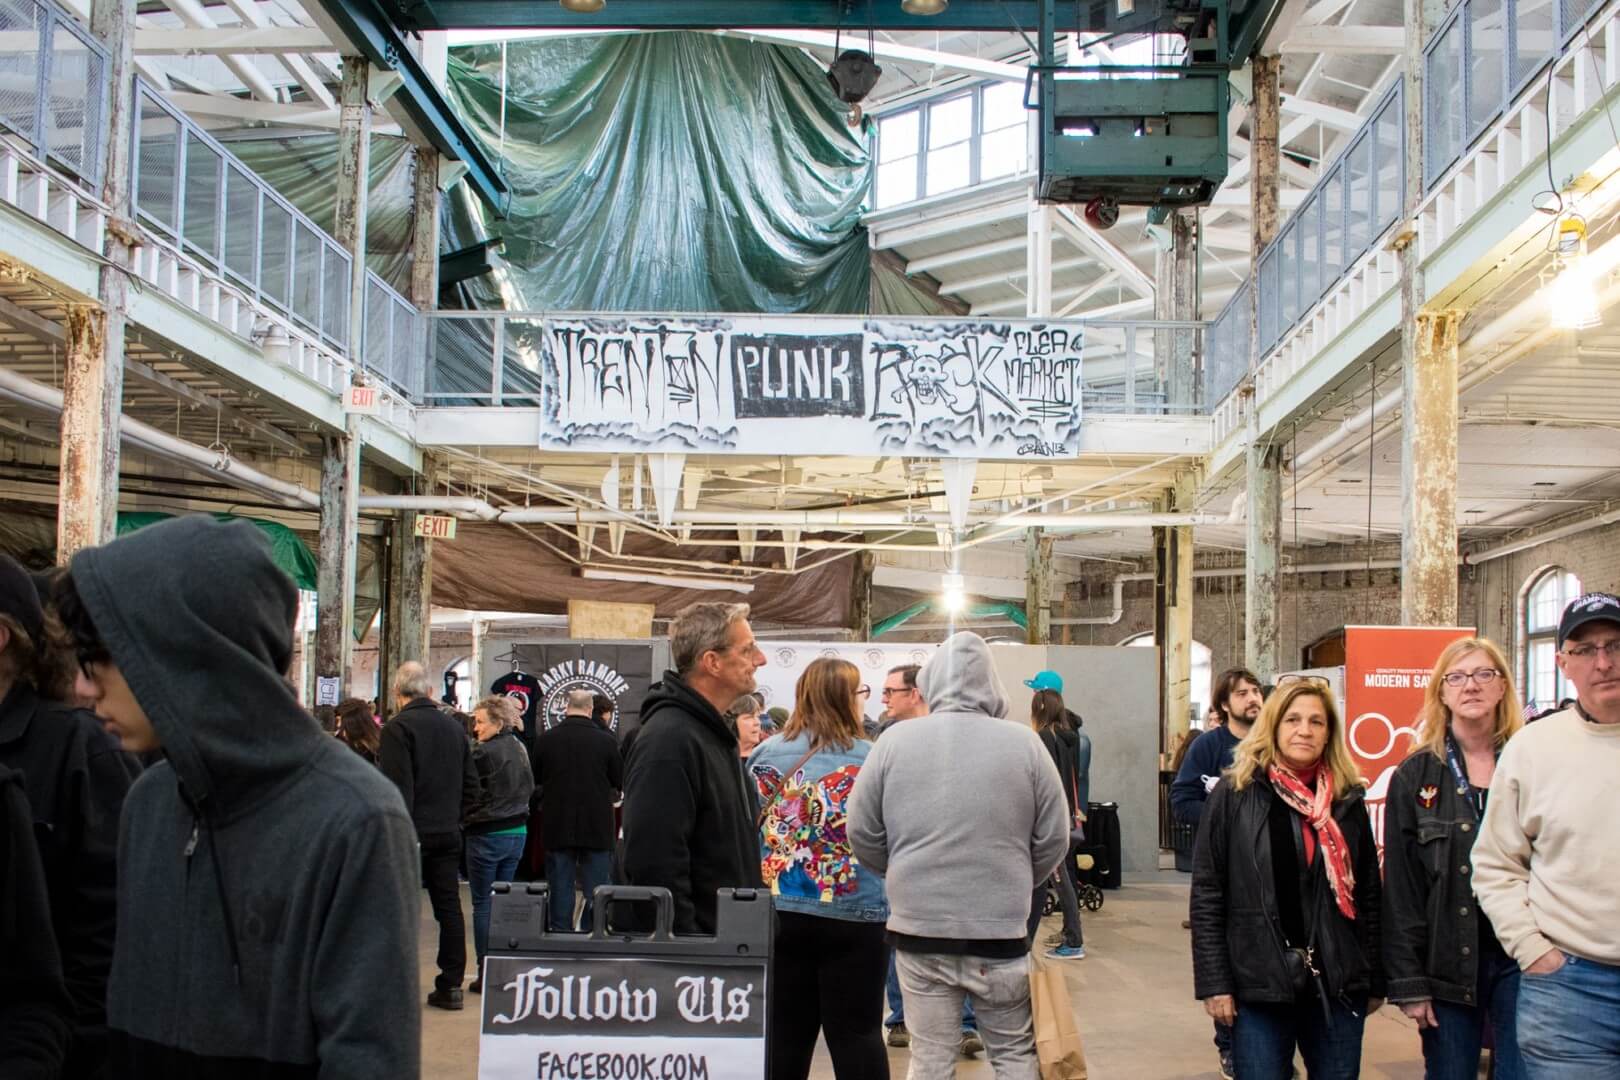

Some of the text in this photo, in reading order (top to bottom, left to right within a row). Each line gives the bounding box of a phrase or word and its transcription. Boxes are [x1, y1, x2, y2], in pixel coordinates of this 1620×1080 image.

[1013, 329, 1068, 356] FLEA
[552, 325, 724, 423] TRENTON
[737, 346, 851, 401] PUNK
[1003, 356, 1081, 405] MARKET
[351, 388, 375, 408] EXIT
[422, 516, 450, 537] EXIT
[578, 658, 630, 696] RAMONE
[1365, 673, 1411, 688] MODERN
[492, 966, 754, 1024] Follow Us
[537, 1051, 710, 1080] FACEBOOK.COM
